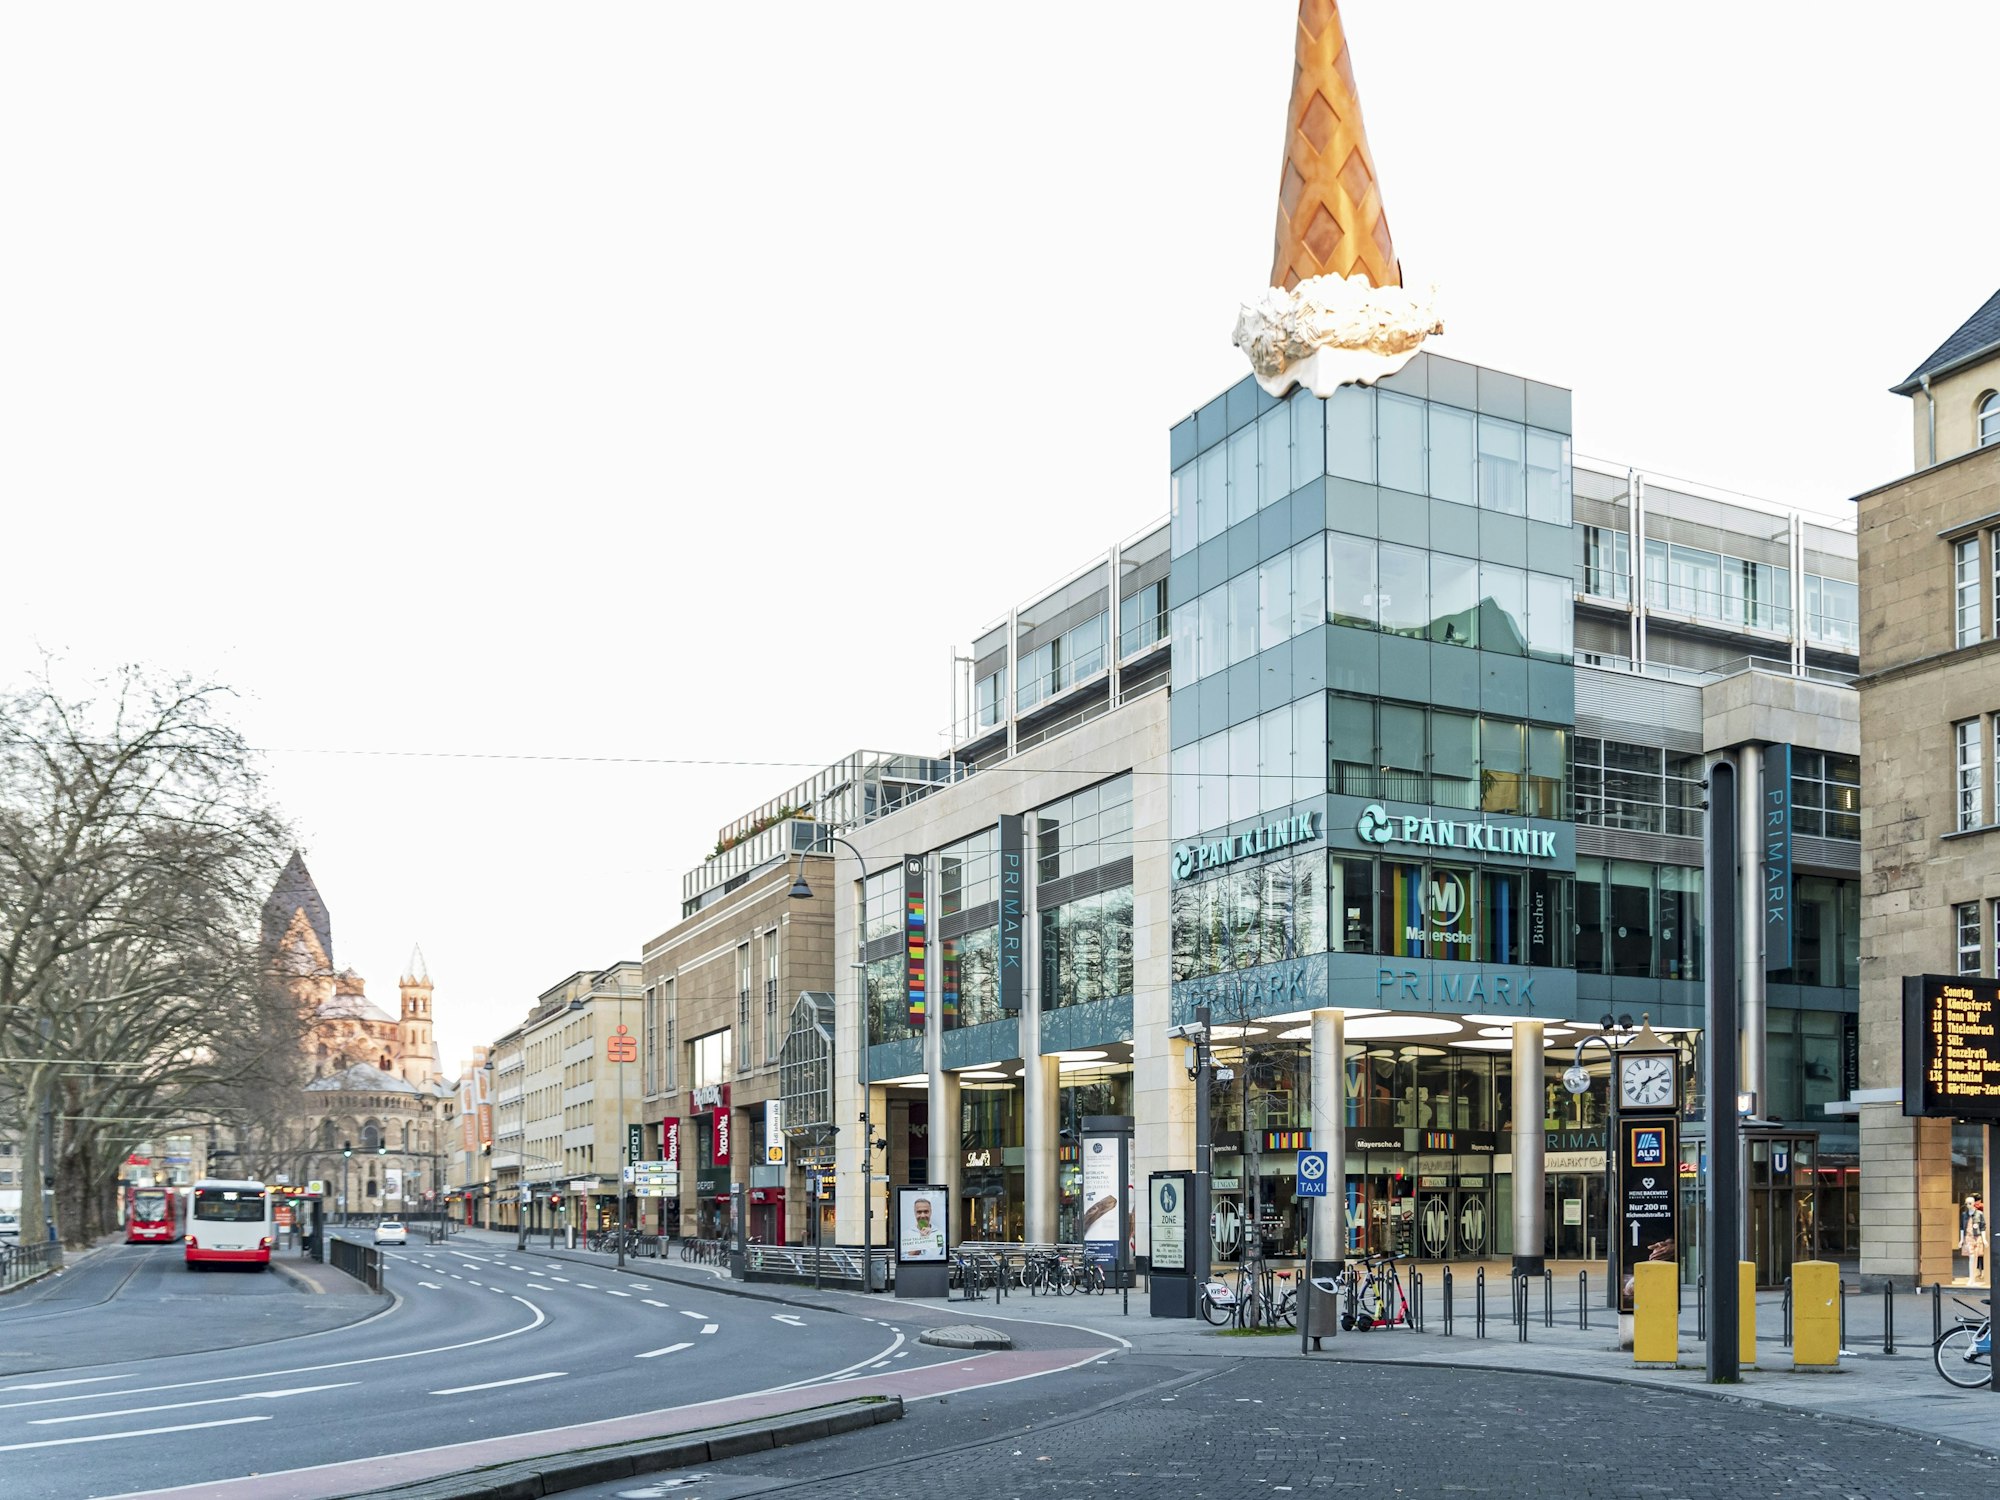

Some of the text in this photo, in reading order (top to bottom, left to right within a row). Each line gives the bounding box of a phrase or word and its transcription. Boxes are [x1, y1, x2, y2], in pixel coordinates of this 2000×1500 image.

[1198, 811, 1316, 870] PAN KLINIK
[1403, 816, 1557, 858] PAN KLINIK
[1768, 790, 1784, 924] PRIMARK
[1004, 854, 1019, 968] PRIMARK
[1533, 891, 1545, 945] Bücher
[1405, 926, 1473, 944] Maersche
[1188, 968, 1305, 1018] PRIMARK
[1375, 967, 1536, 1007] PRIMARK
[1943, 985, 1974, 1000] Sonntag
[1936, 997, 1992, 1012] 9 Königsforst
[1932, 1009, 1981, 1023] 18 Bonn Hbf
[1932, 1021, 1995, 1036] 18 Thielenbruch
[1936, 1034, 1964, 1046] 9 Sülz
[1936, 1046, 1943, 1057] 7
[1936, 1082, 1943, 1094] 3
[1213, 1145, 1238, 1153] ayersche.de
[1356, 1140, 1401, 1151] Mayersche.de
[1637, 1149, 1660, 1157] ALDI
[1774, 1153, 1788, 1172] U
[1300, 1182, 1325, 1193] TAXI
[1629, 1203, 1644, 1211] Nur
[1644, 1203, 1659, 1211] 200
[1161, 1215, 1177, 1224] ZONE
